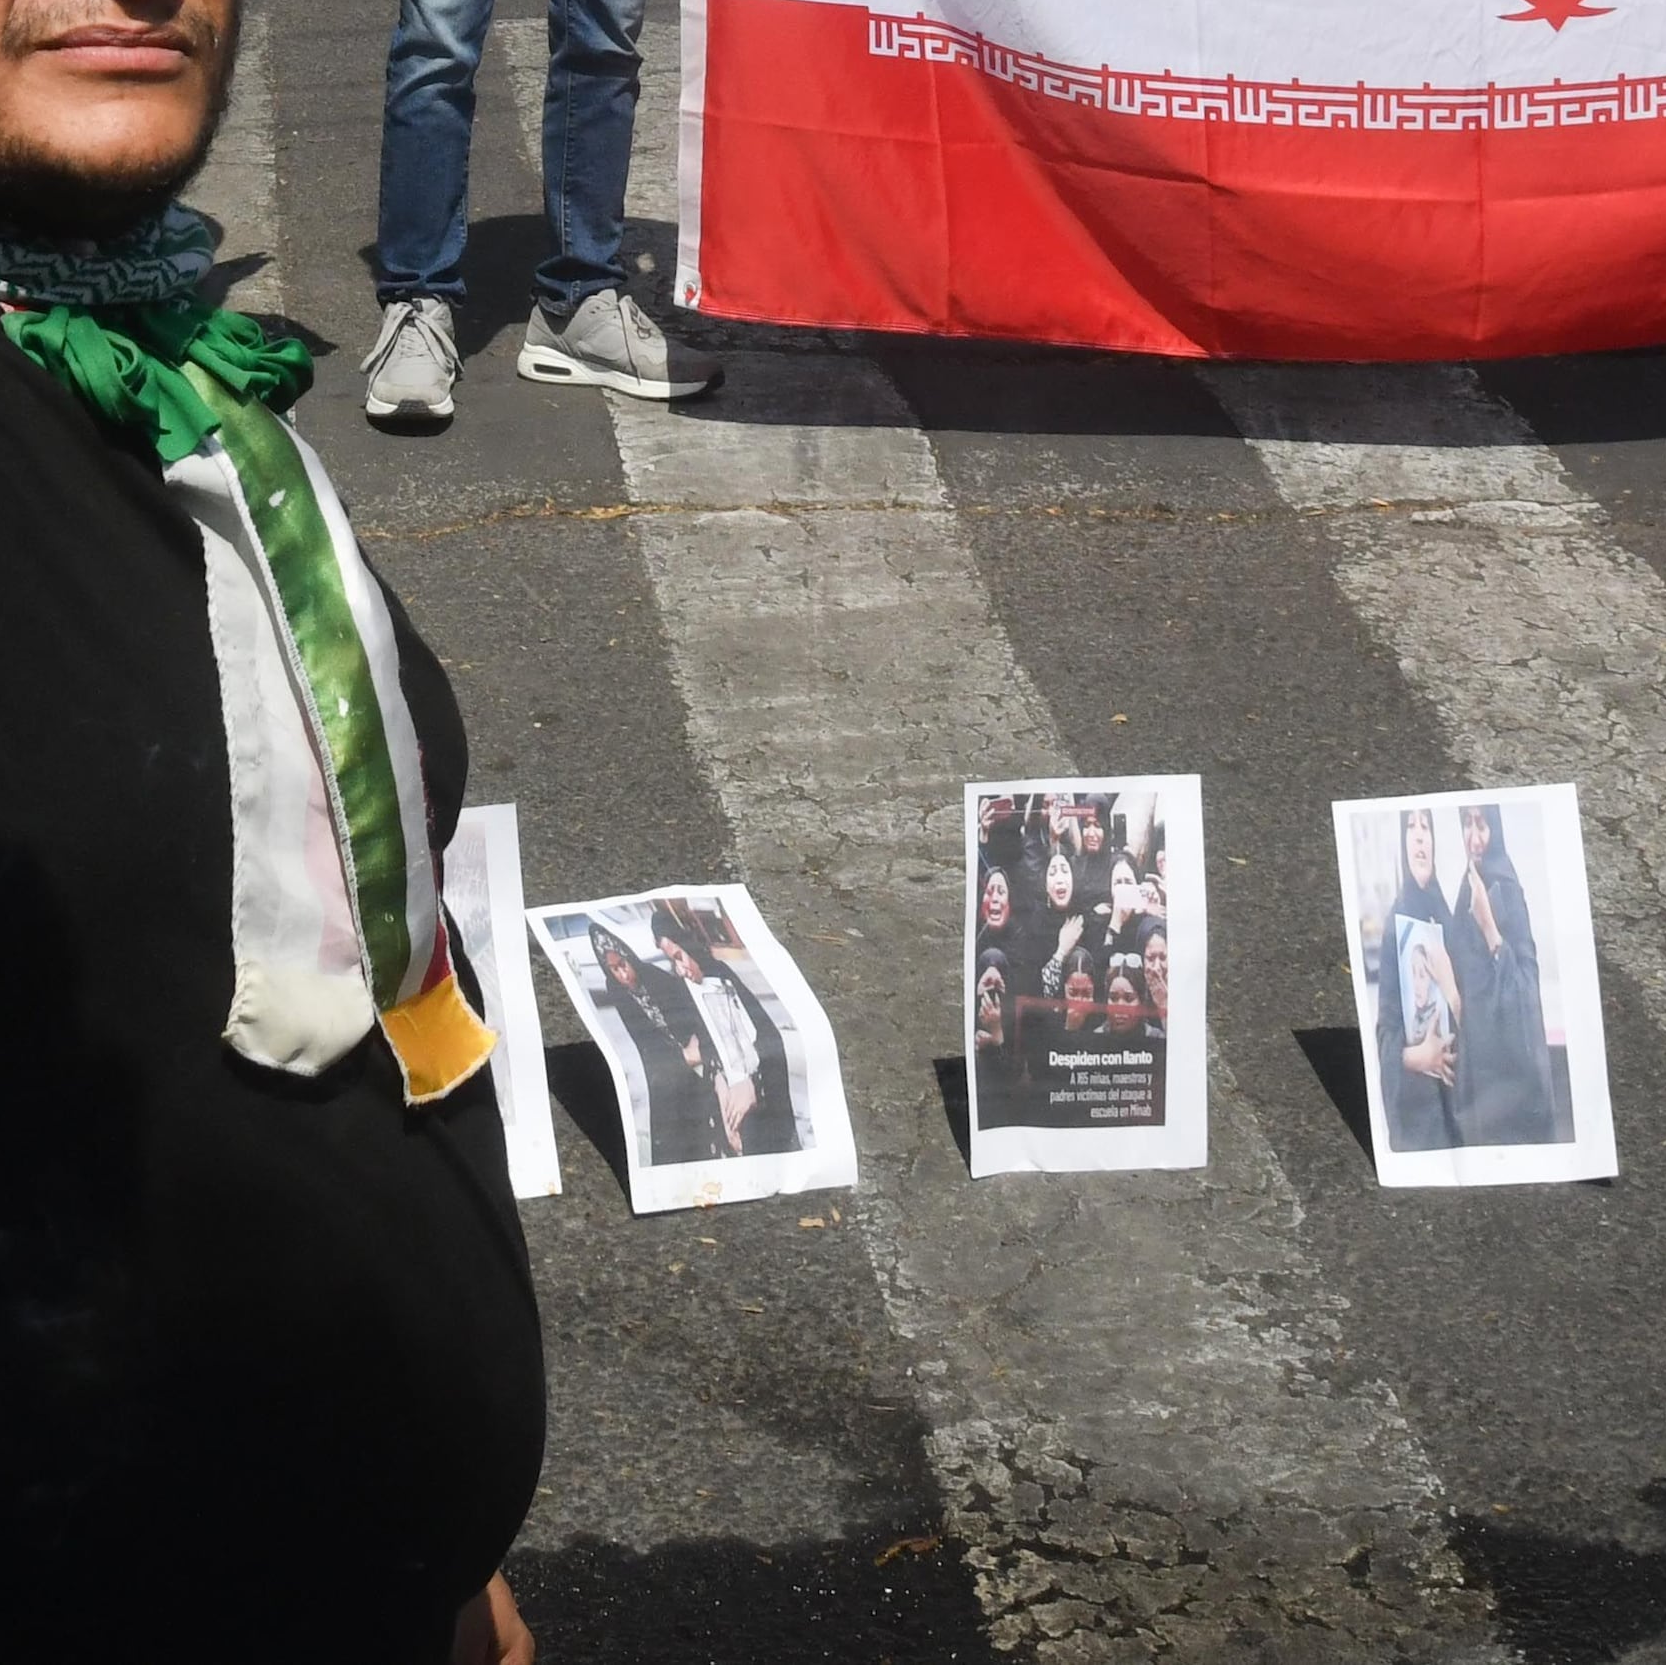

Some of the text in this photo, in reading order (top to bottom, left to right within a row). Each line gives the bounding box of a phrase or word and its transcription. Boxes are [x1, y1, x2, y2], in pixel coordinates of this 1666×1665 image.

[1049, 1050, 1153, 1069] Despiden con llanto
